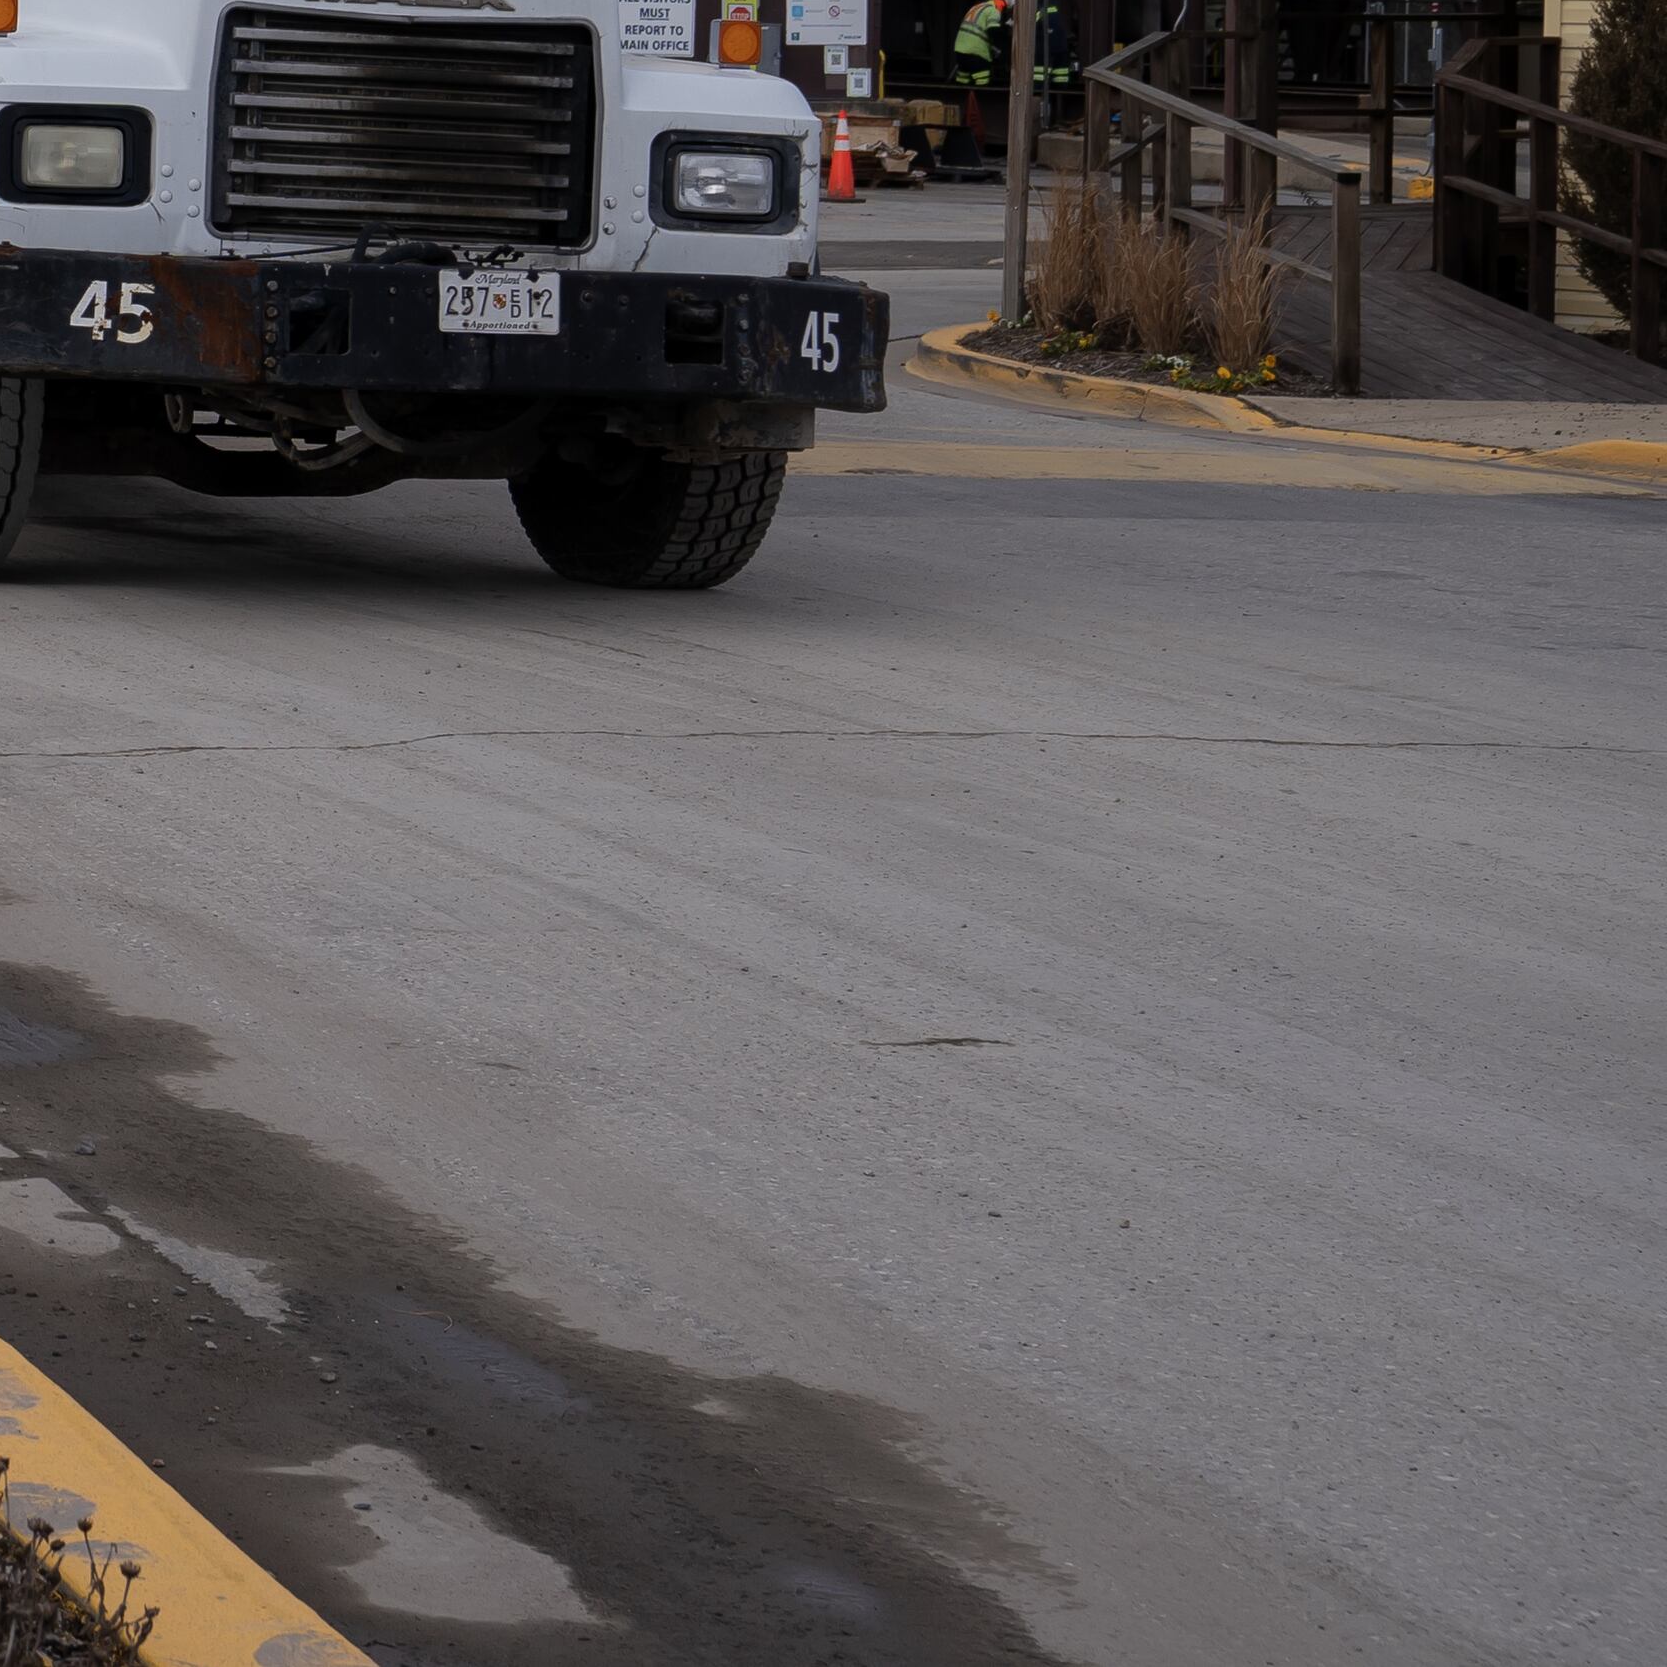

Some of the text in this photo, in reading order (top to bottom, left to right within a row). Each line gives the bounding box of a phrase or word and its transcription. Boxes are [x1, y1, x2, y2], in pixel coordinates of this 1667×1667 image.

[639, 8, 670, 18] MUST
[625, 25, 683, 36] REPORT TO
[652, 41, 689, 51] OFFICE
[475, 274, 522, 287] Maryland
[69, 280, 156, 344] 45
[468, 320, 531, 331] Apportioned
[800, 310, 840, 373] 45
